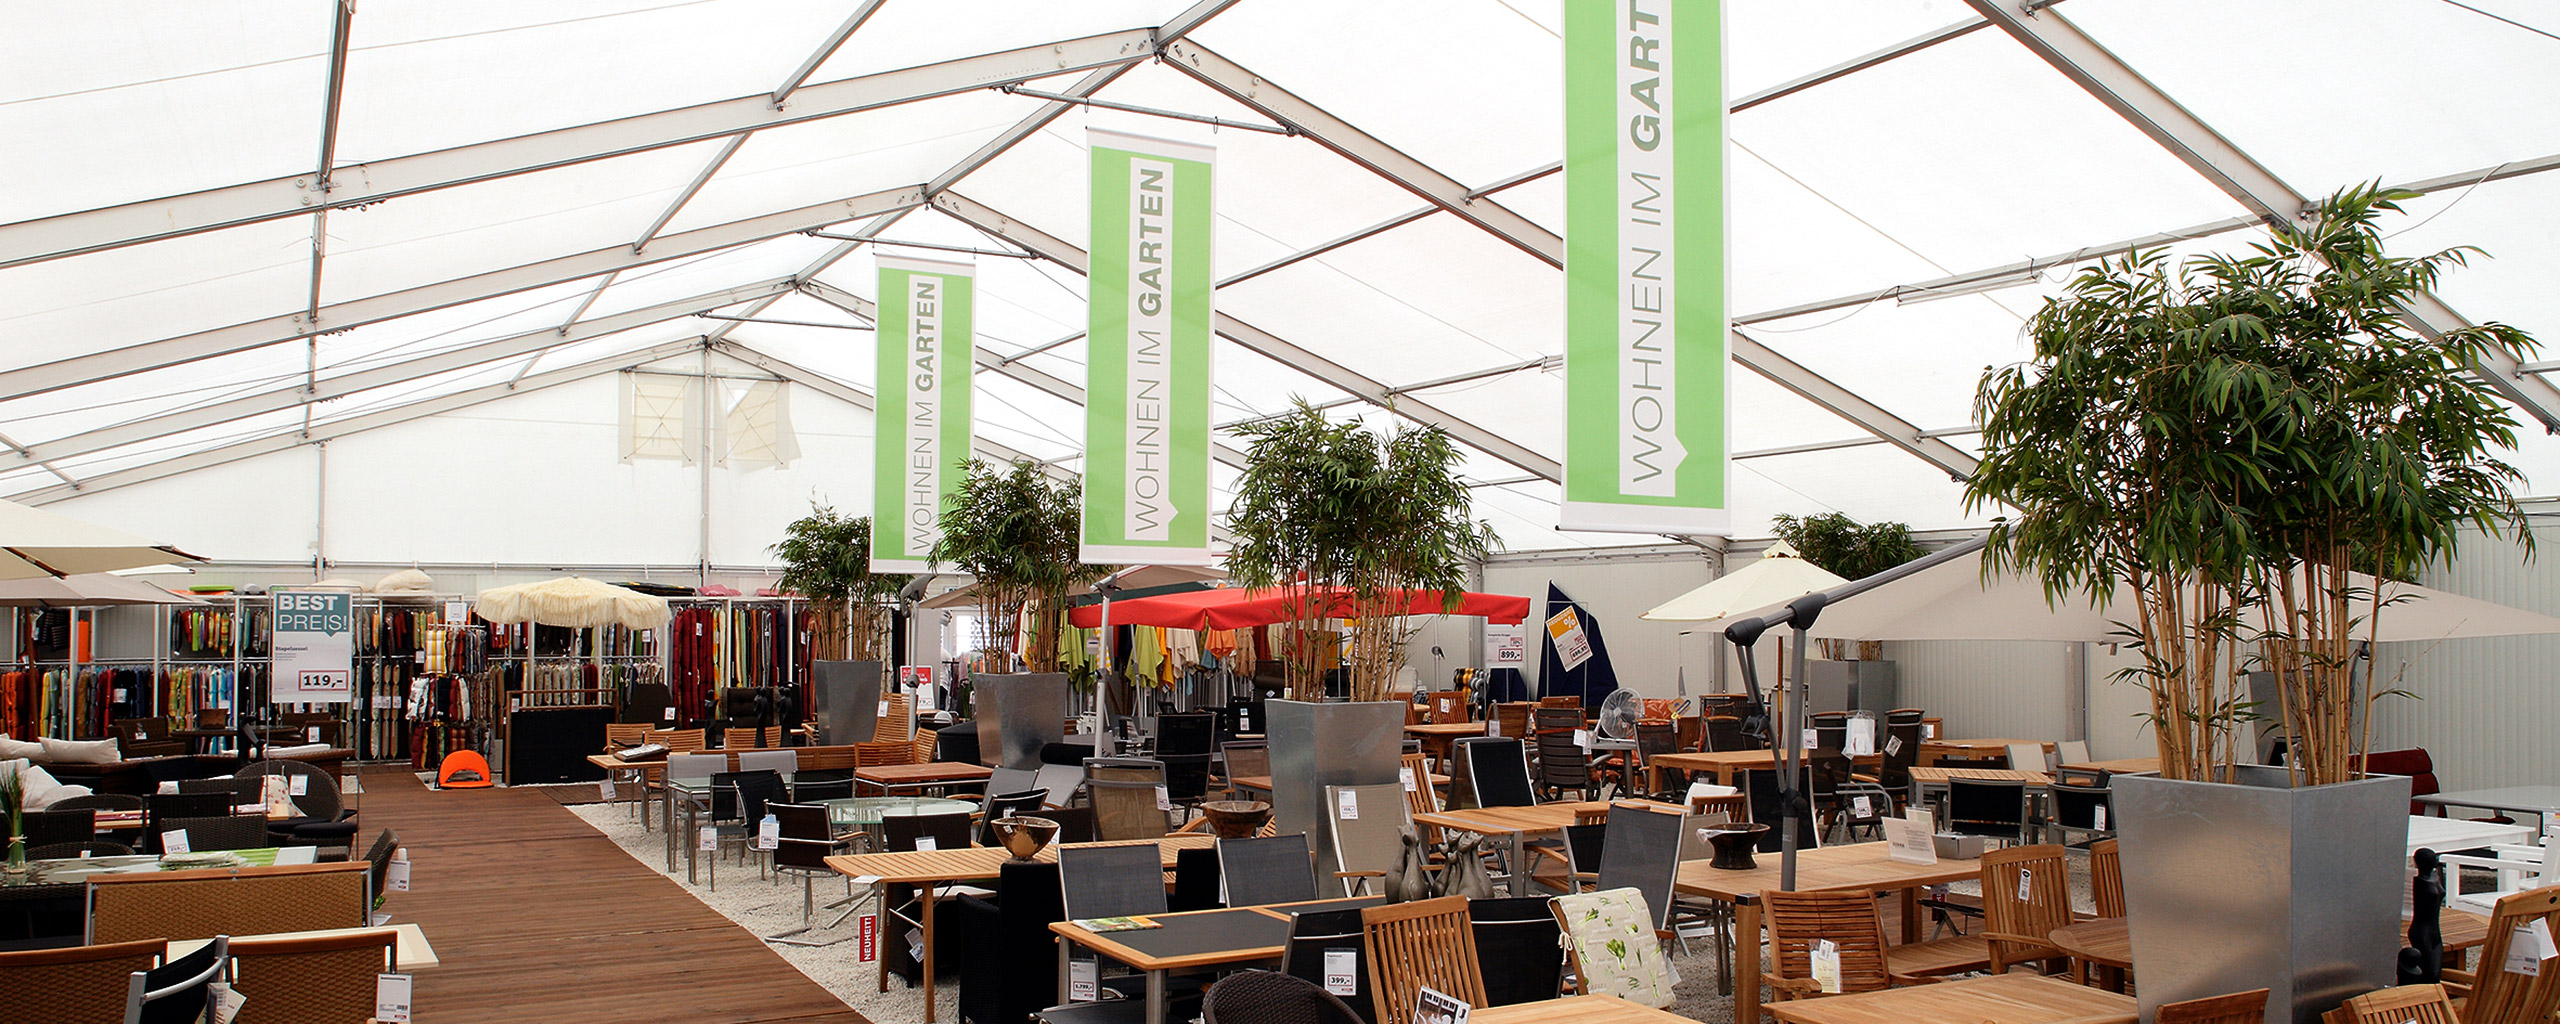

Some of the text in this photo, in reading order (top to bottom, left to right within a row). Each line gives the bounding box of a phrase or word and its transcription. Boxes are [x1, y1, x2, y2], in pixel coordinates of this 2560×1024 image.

[1630, 0, 1662, 482] WOHNEN IM GART
[1134, 168, 1164, 532] WOHNEN IM GARTEN
[912, 282, 935, 550] WOHNEN IM GARTEN
[279, 594, 338, 611] BEST
[279, 614, 347, 631] PREIS!
[1501, 650, 1521, 659] 899,-
[303, 674, 343, 688] 119,-
[864, 917, 872, 960] NEUHEIT!
